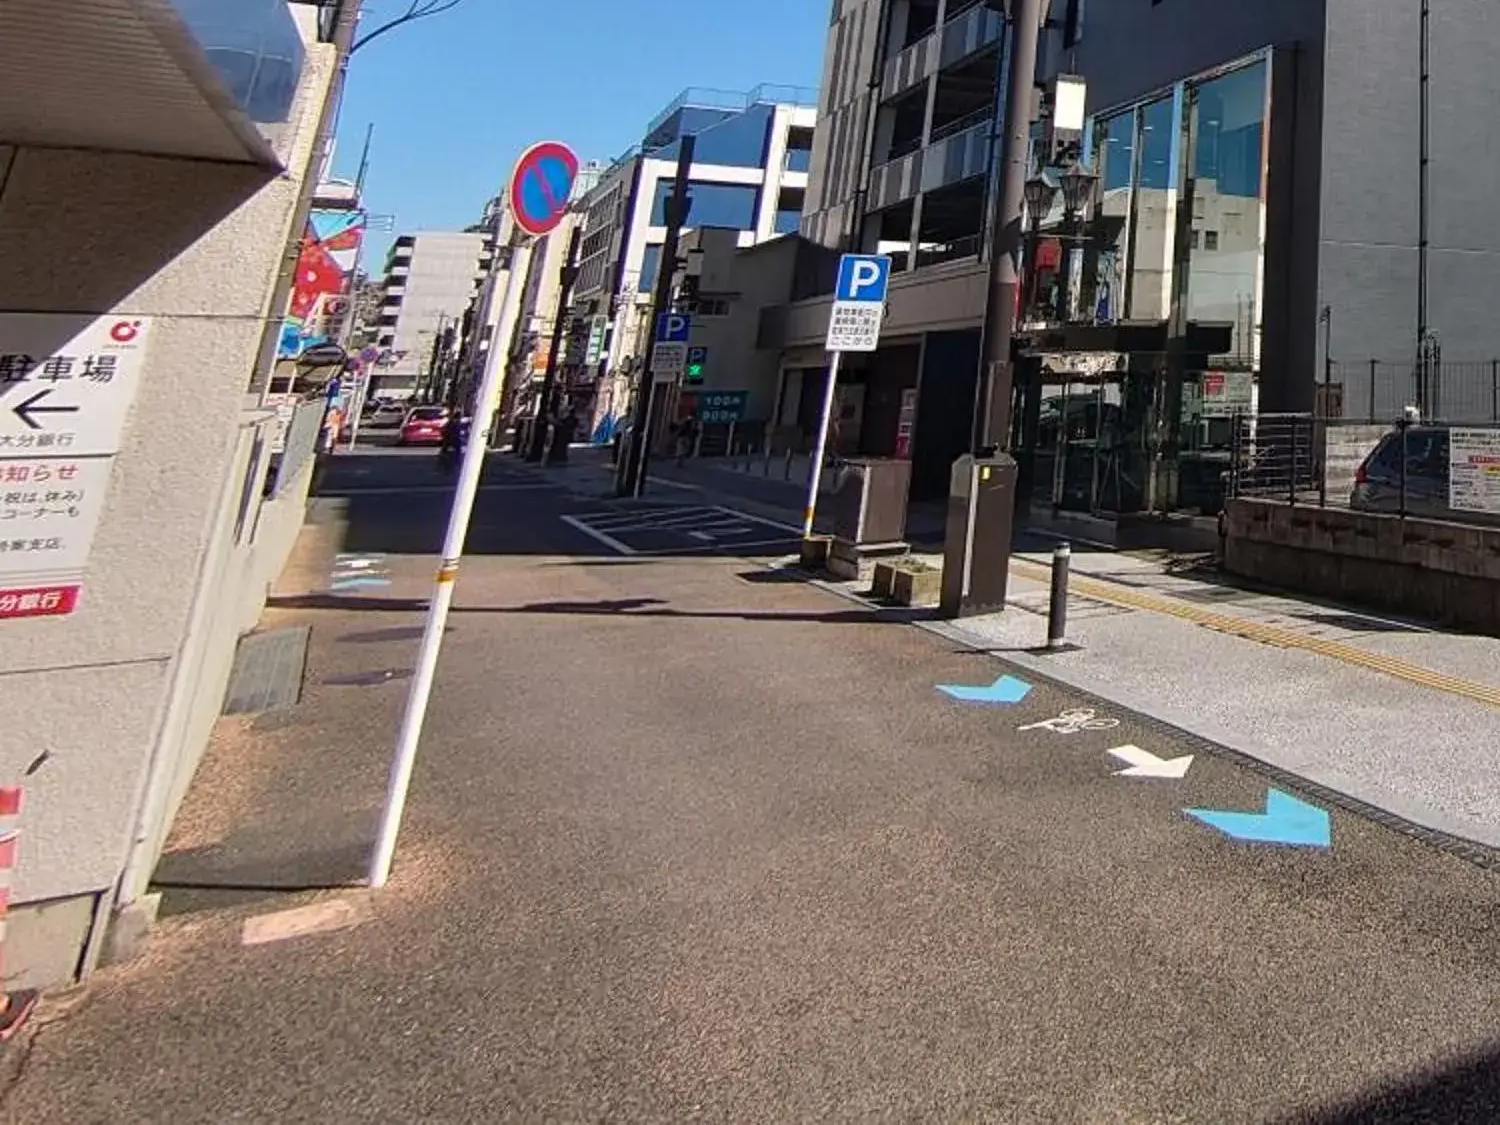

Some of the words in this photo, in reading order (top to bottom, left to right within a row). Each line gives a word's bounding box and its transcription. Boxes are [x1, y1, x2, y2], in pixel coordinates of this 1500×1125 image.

[849, 260, 880, 298] P
[664, 316, 686, 339] P
[0, 354, 118, 383] 駐車場
[0, 464, 78, 482] 知らせ
